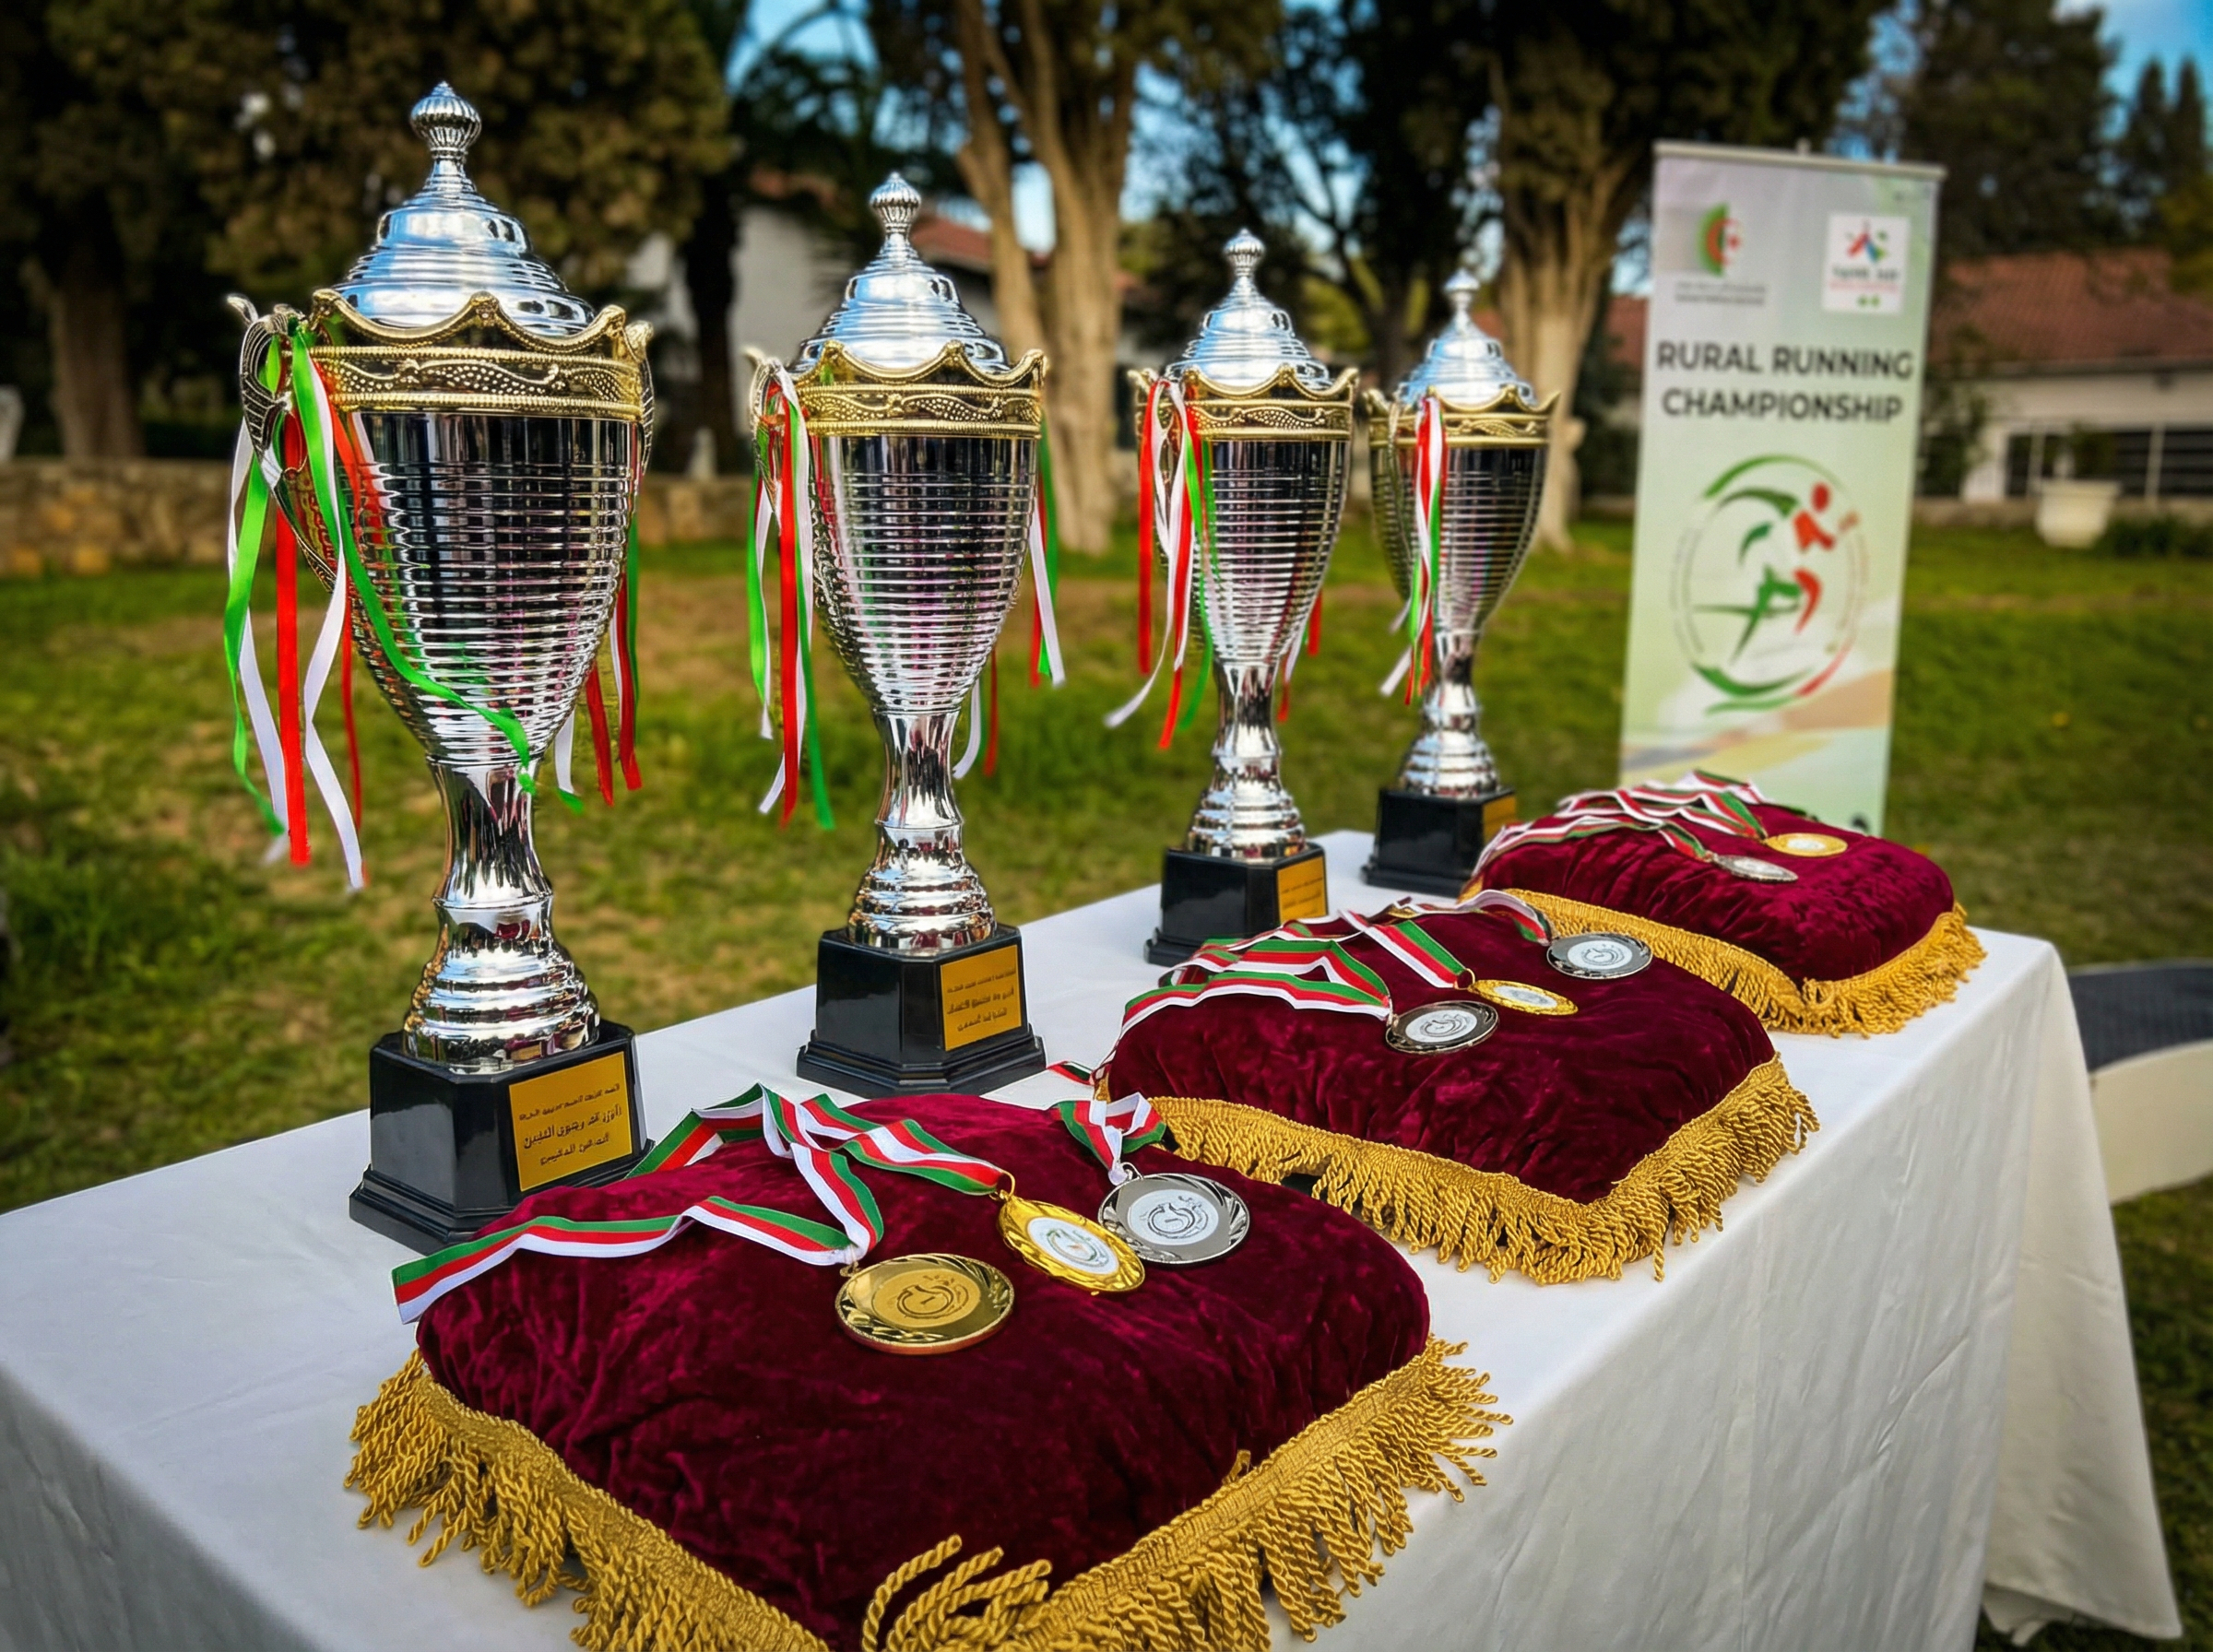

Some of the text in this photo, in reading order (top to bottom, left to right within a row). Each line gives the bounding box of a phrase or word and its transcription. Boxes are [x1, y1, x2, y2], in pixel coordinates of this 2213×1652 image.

[1657, 340, 1914, 380] RURAL RUNNING
[1662, 387, 1903, 421] CHAMPIONSHIP
